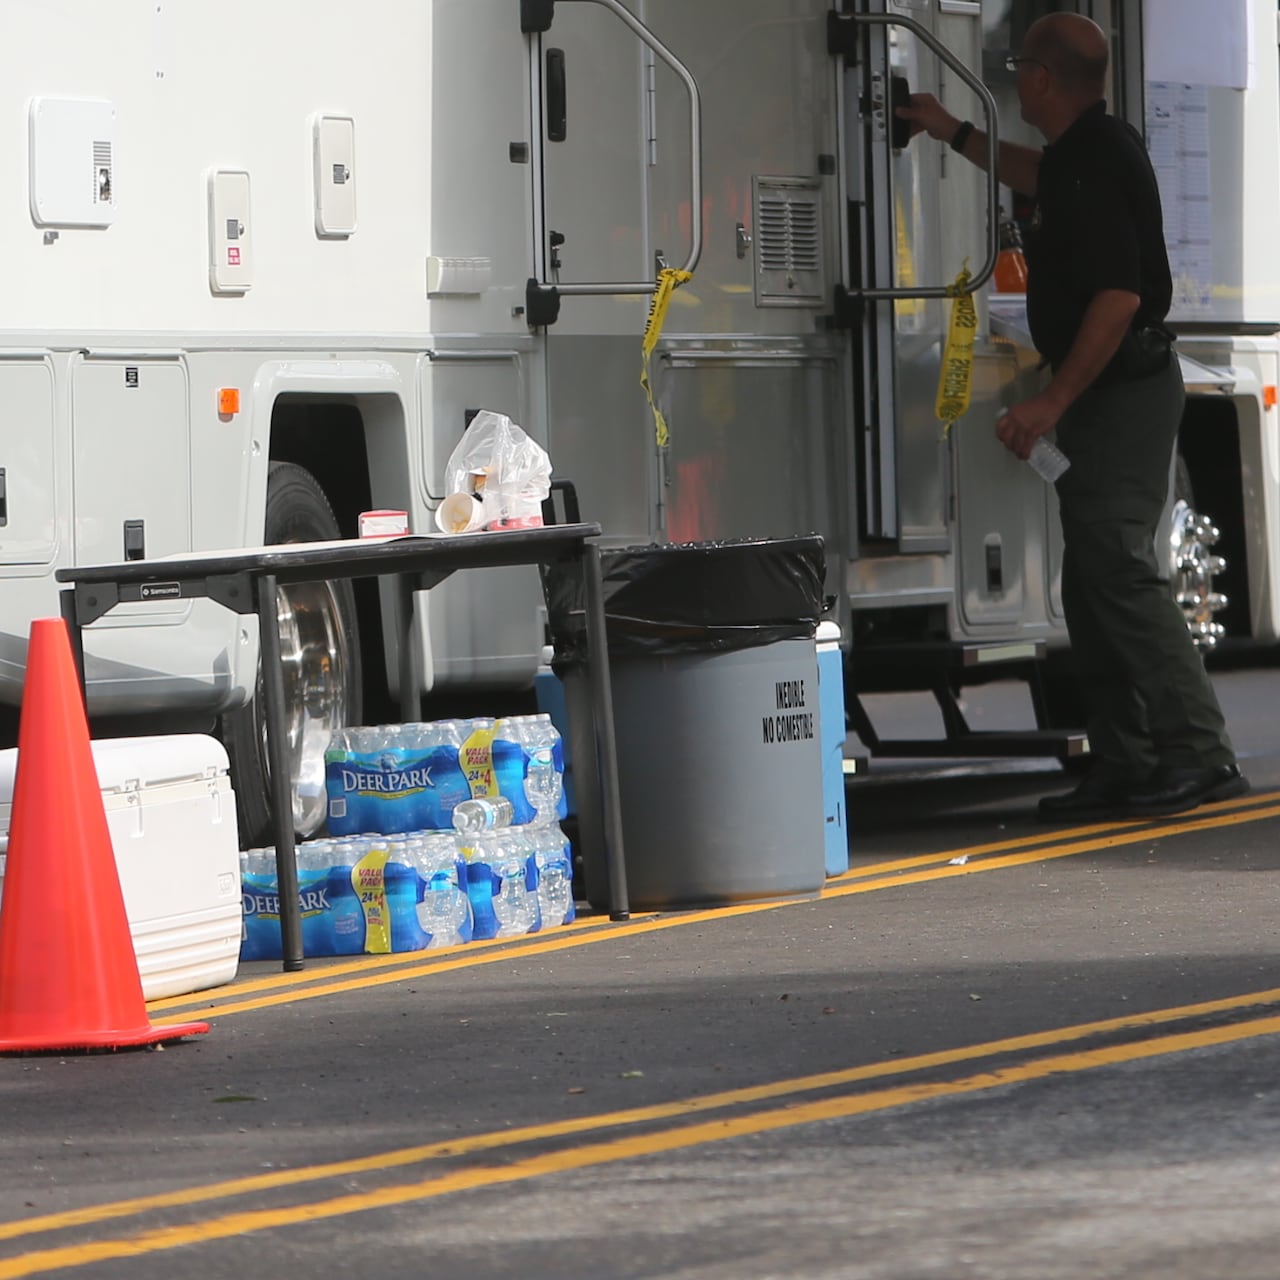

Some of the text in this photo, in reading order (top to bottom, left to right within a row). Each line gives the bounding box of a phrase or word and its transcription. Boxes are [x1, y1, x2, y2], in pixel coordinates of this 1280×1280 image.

[775, 679, 805, 710] INEDIBLE
[762, 712, 814, 744] NO COMESTIBLE
[342, 766, 435, 792] DEER PARK
[298, 888, 331, 910] ARK
